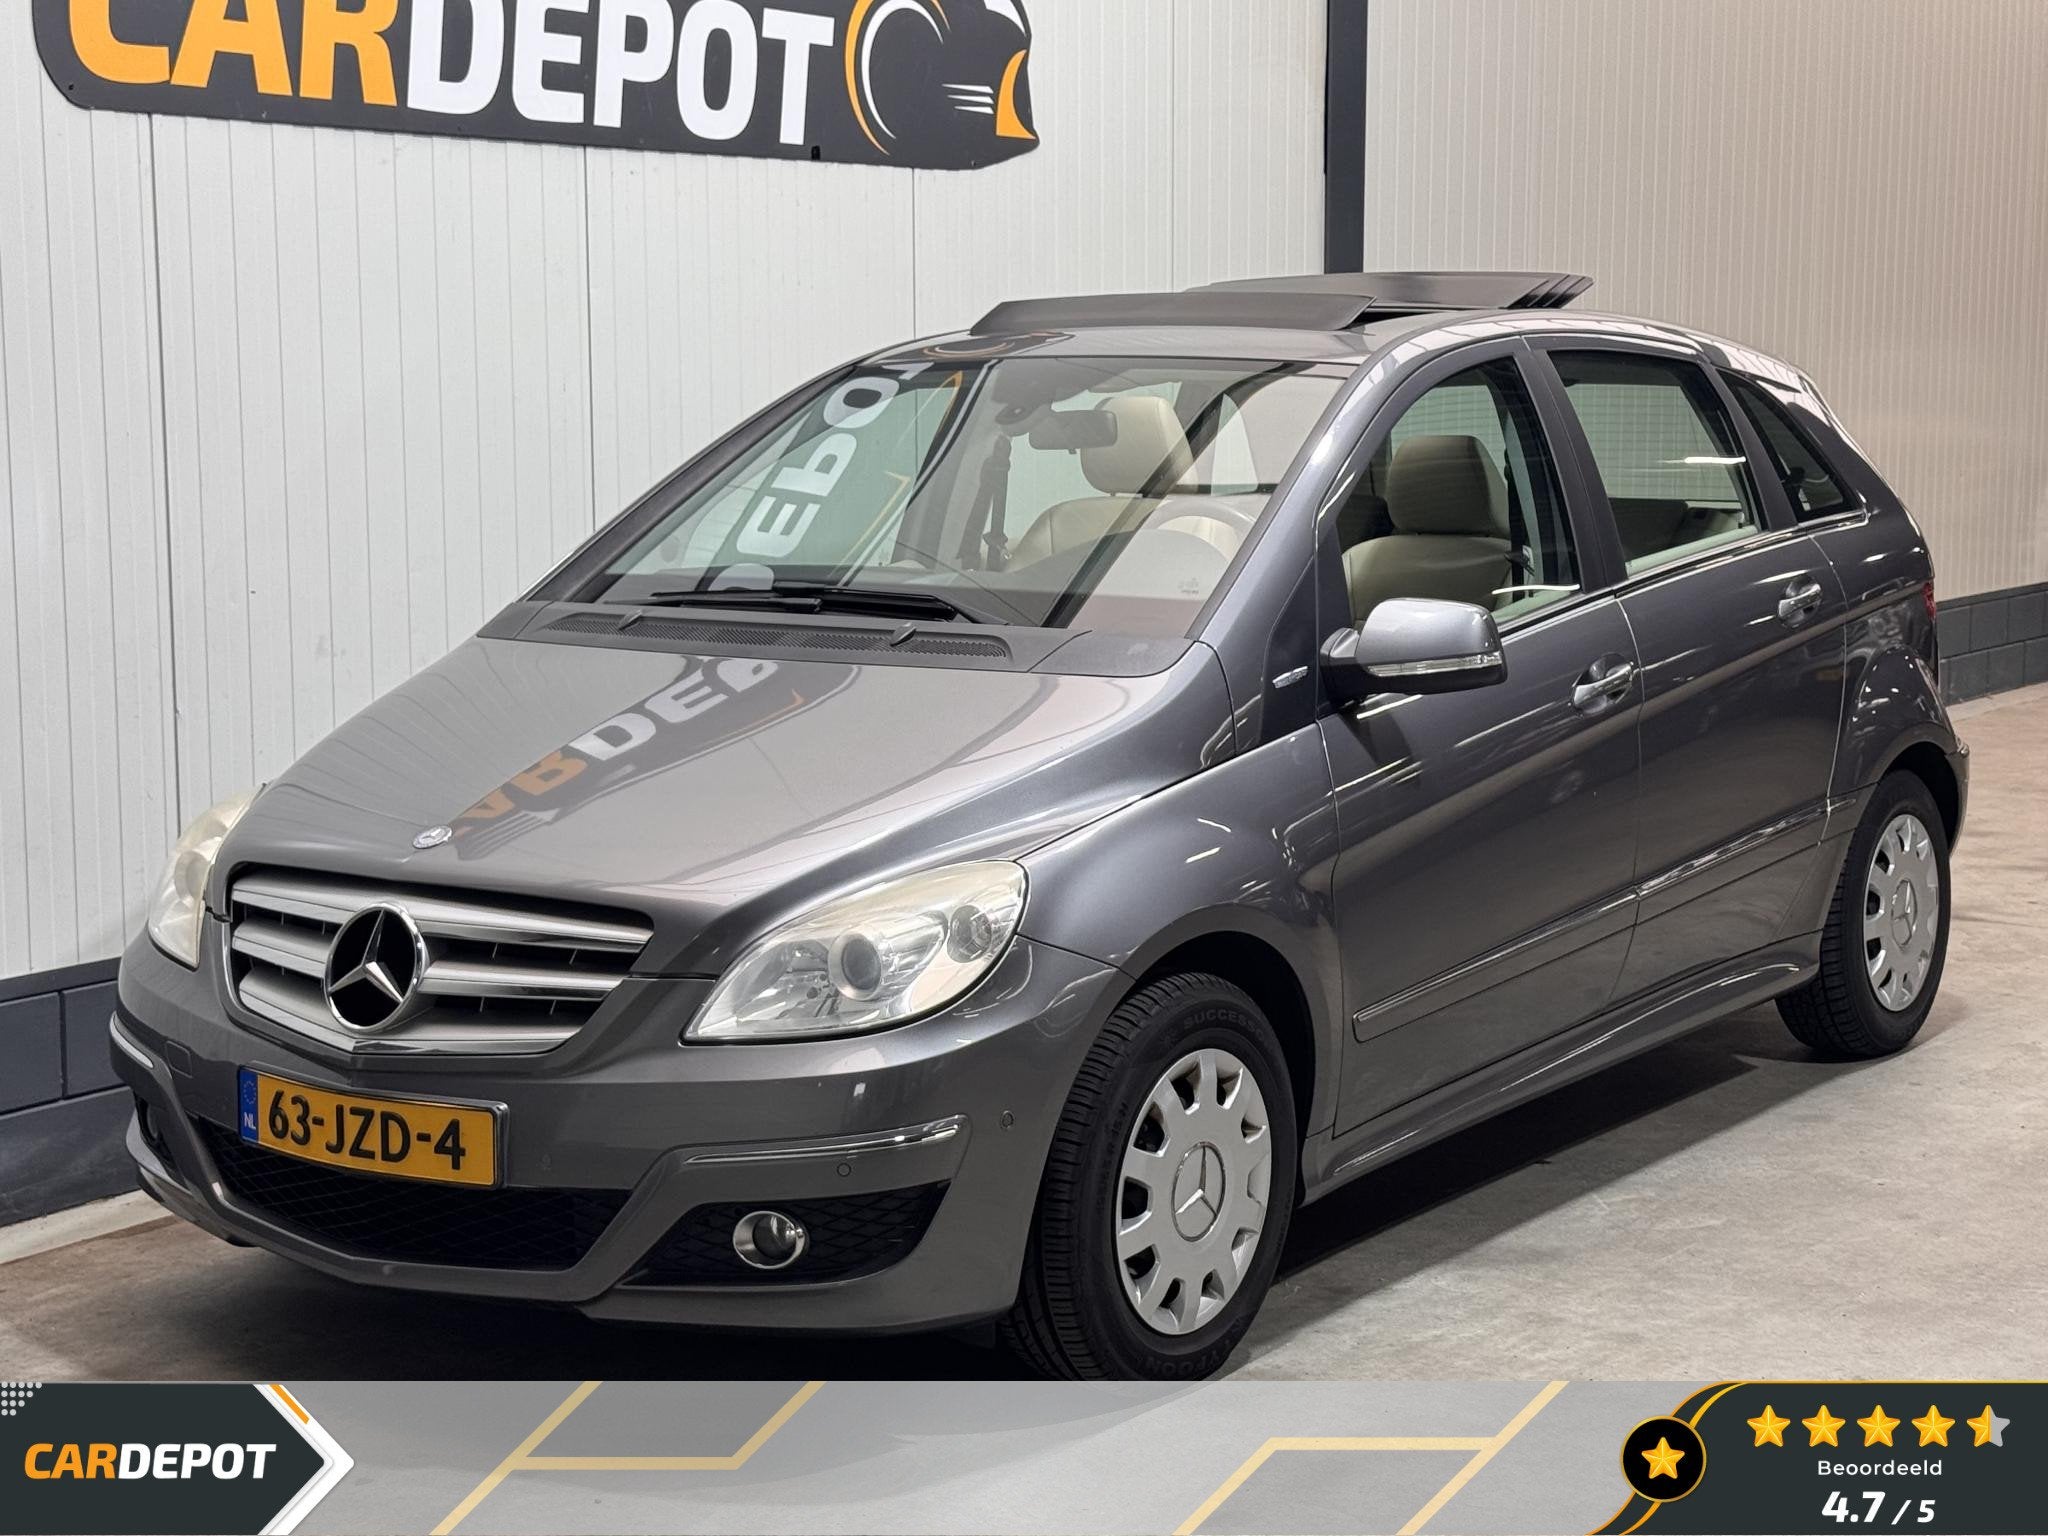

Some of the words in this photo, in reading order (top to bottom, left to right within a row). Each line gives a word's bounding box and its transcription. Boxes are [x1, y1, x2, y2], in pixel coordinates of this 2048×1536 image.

[69, 0, 835, 145] CARDEPOT
[244, 1112, 257, 1130] NL
[268, 1089, 466, 1171] 63-JZD-4
